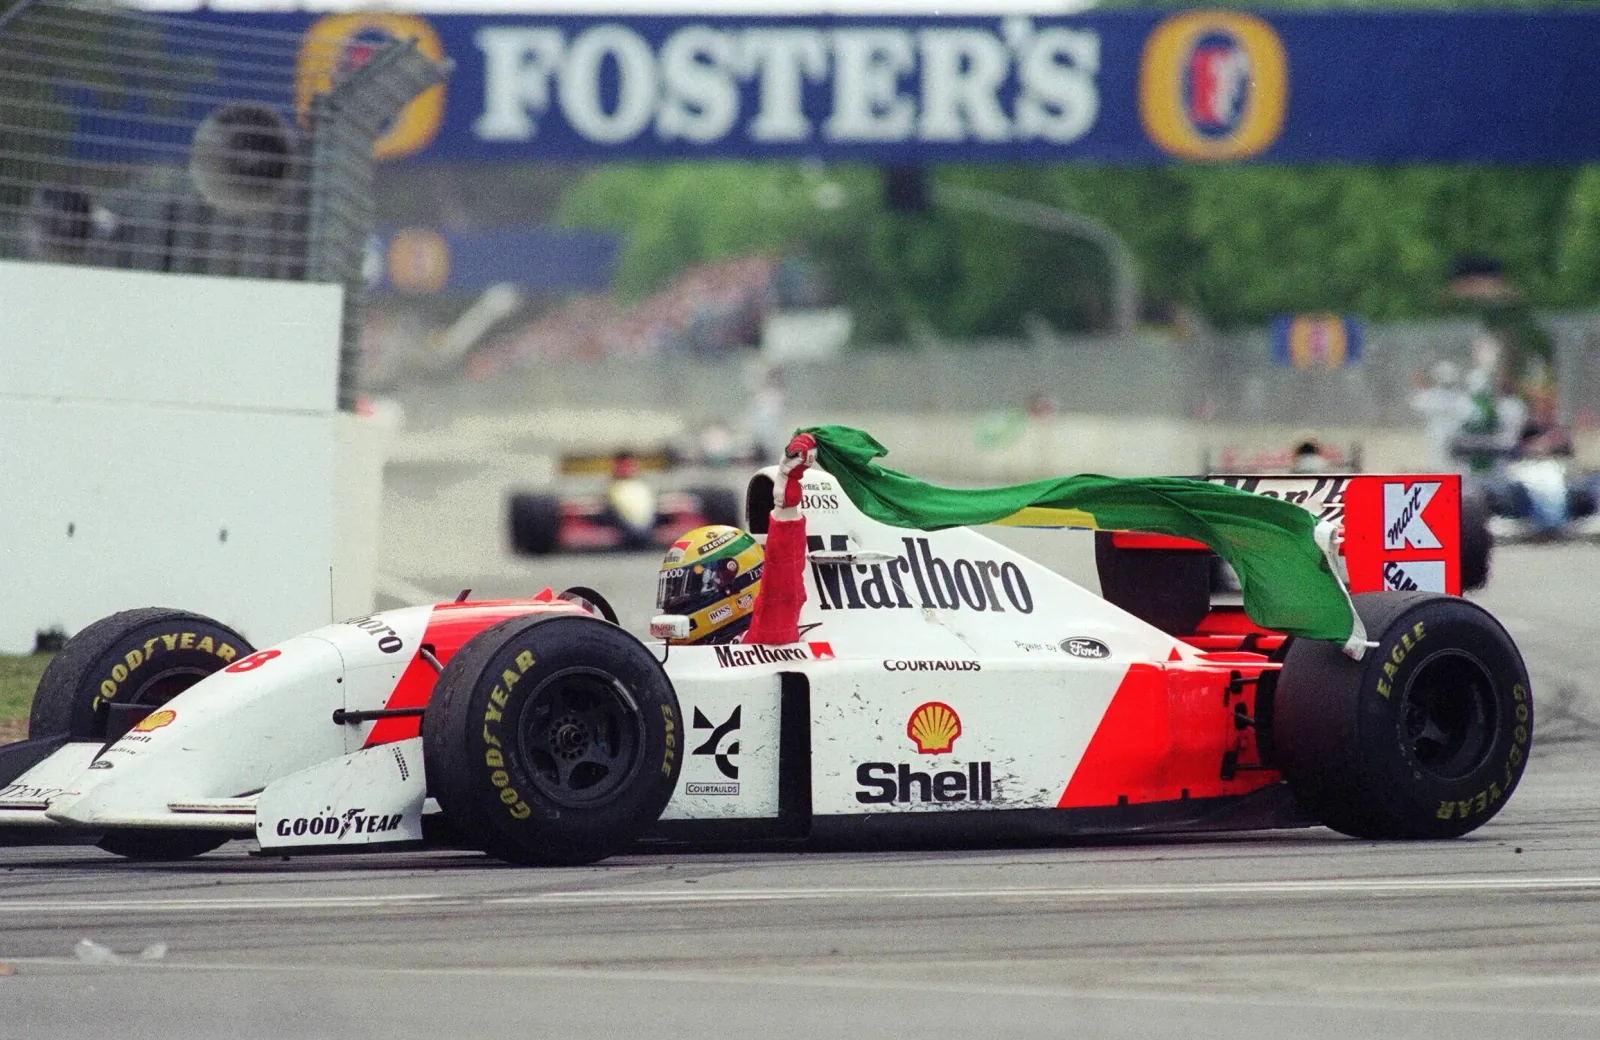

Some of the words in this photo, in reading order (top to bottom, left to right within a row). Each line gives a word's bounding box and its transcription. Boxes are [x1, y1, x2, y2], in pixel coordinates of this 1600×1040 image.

[474, 19, 1101, 143] FOSTER'S
[801, 494, 839, 510] BOSS
[807, 534, 1034, 615] Marlboro
[709, 605, 731, 621] BOSS
[224, 649, 281, 673] 8
[713, 644, 809, 669] Marlboro
[1069, 640, 1103, 658] Ford
[1377, 621, 1427, 699] EAGLE
[883, 659, 981, 672] COURTAULDS
[660, 703, 676, 779] EAGLE
[687, 784, 738, 794] COURTAULDS
[855, 761, 992, 805] Shell
